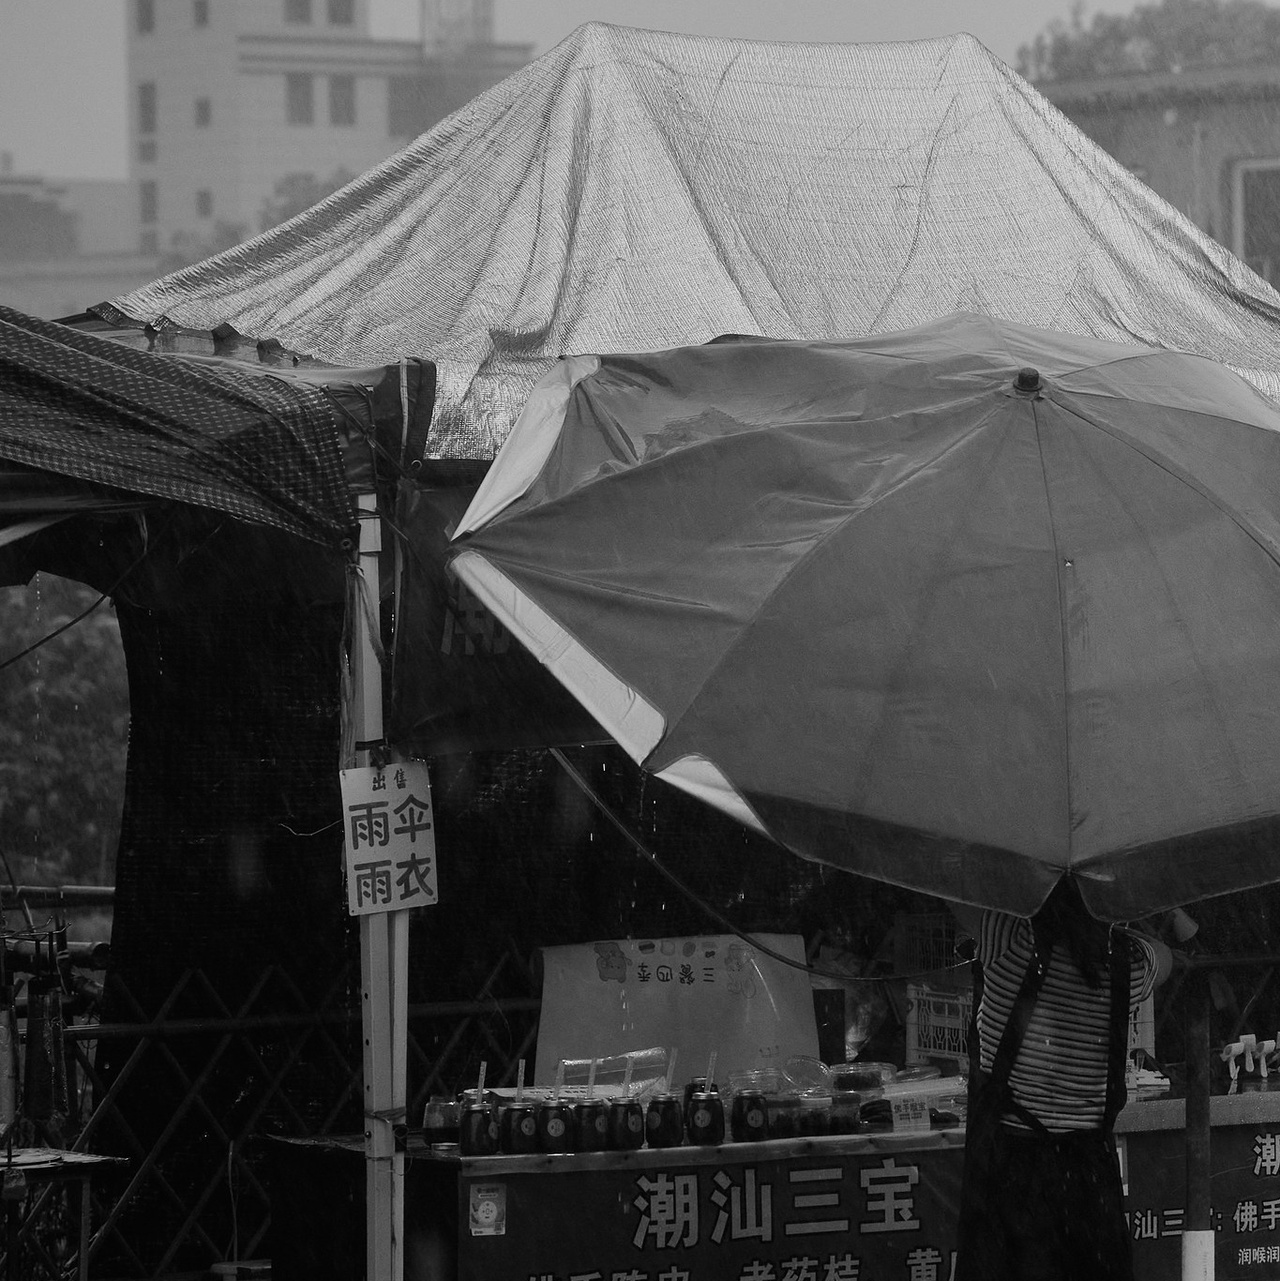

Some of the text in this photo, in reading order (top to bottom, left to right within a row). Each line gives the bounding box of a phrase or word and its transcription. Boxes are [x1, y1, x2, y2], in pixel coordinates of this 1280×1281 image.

[372, 768, 408, 792] 出售
[348, 793, 431, 850] 雨伞
[353, 852, 434, 908] 雨衣
[637, 962, 715, 986] 三餐四季
[632, 1158, 921, 1250] 潮汕三宝
